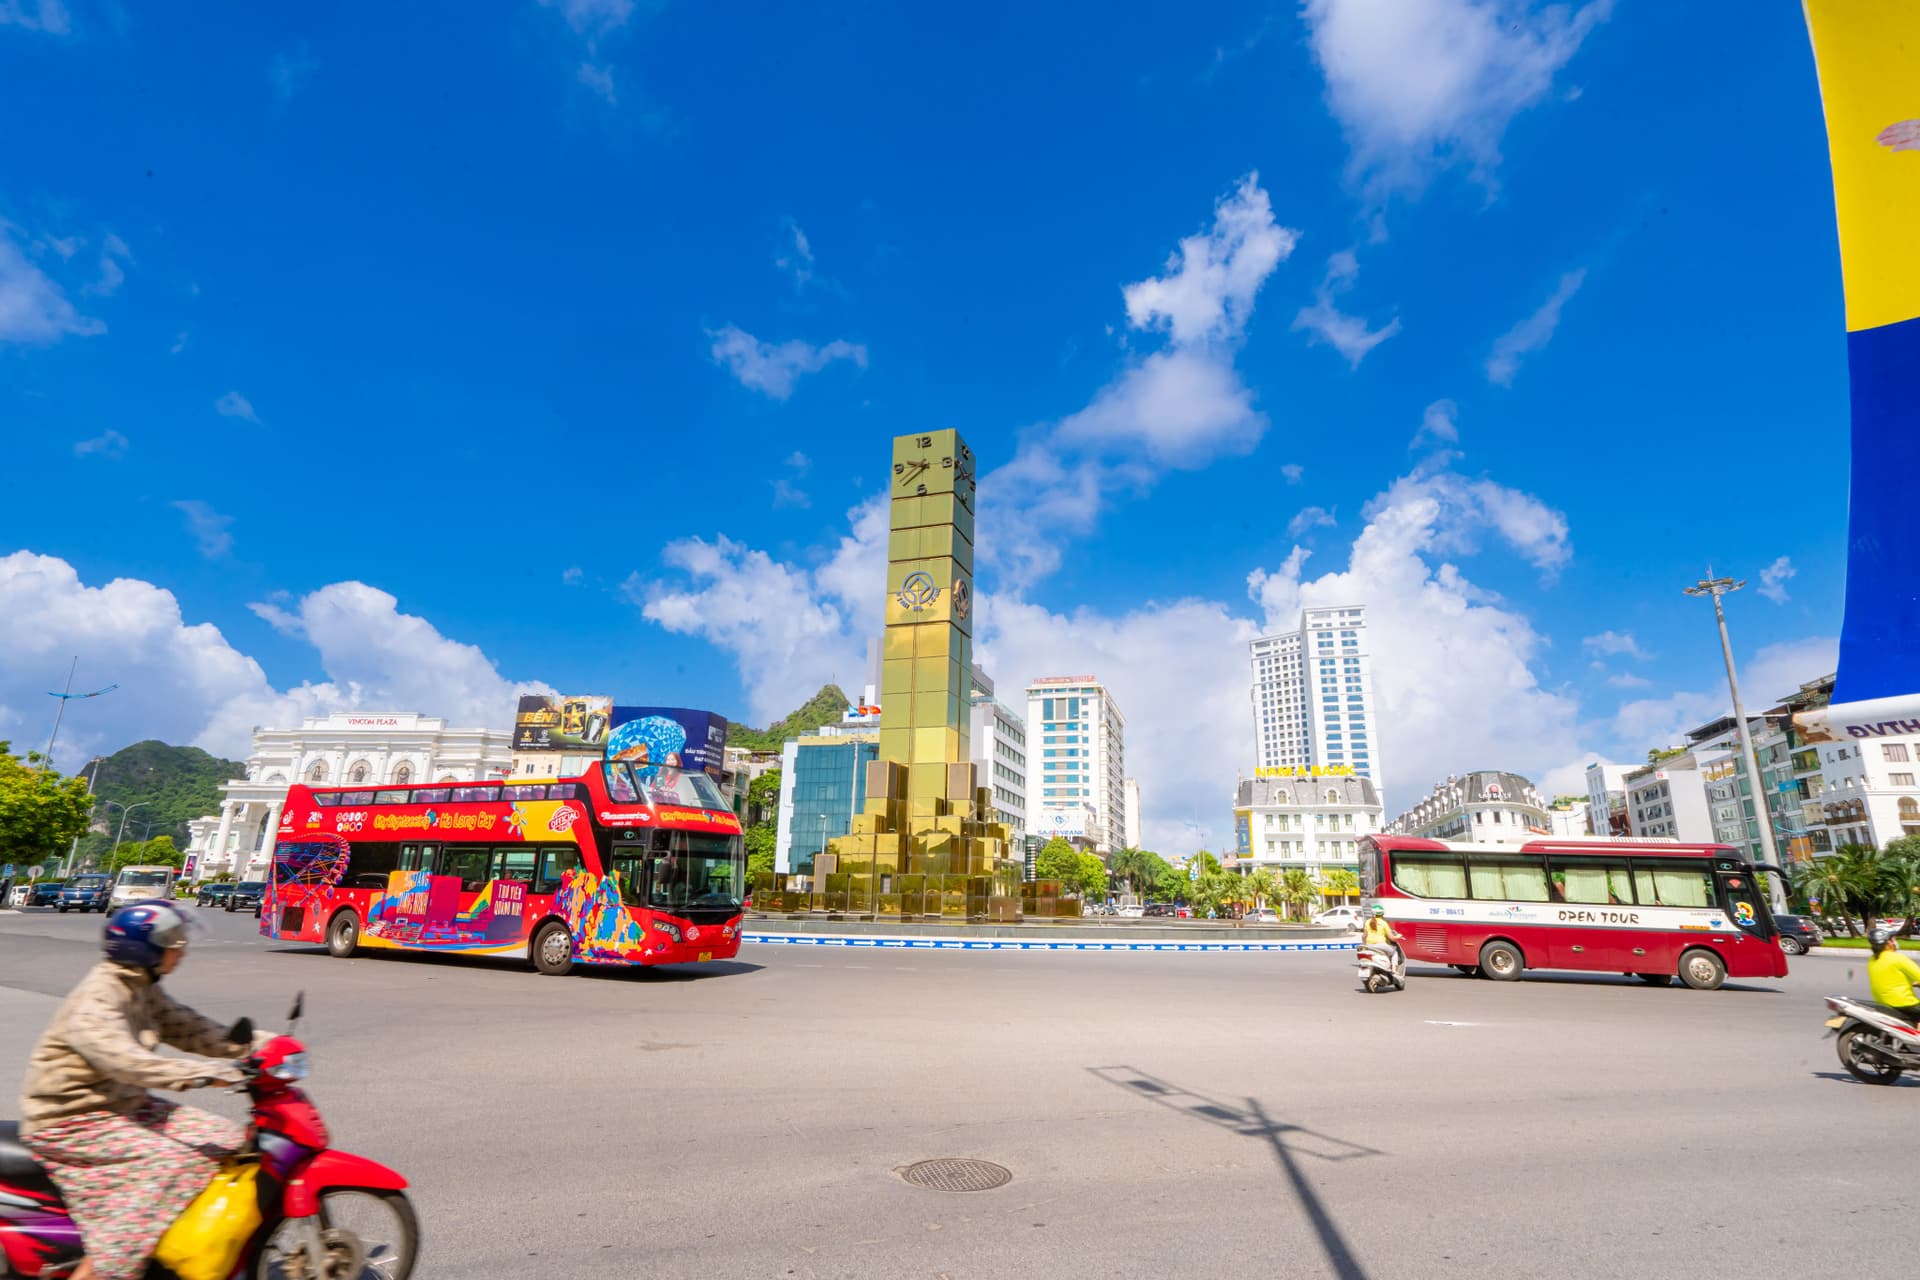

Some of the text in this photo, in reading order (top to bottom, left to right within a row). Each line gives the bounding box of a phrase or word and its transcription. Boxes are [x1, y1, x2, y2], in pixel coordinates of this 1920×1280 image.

[916, 436, 932, 448] 12
[894, 456, 953, 474] 9 3
[917, 484, 927, 496] 6
[348, 718, 398, 726] VINCOM PLAZA
[1255, 764, 1357, 777] NAM A BANK
[453, 812, 477, 831] Long
[1558, 910, 1639, 925] OPEN TOUR
